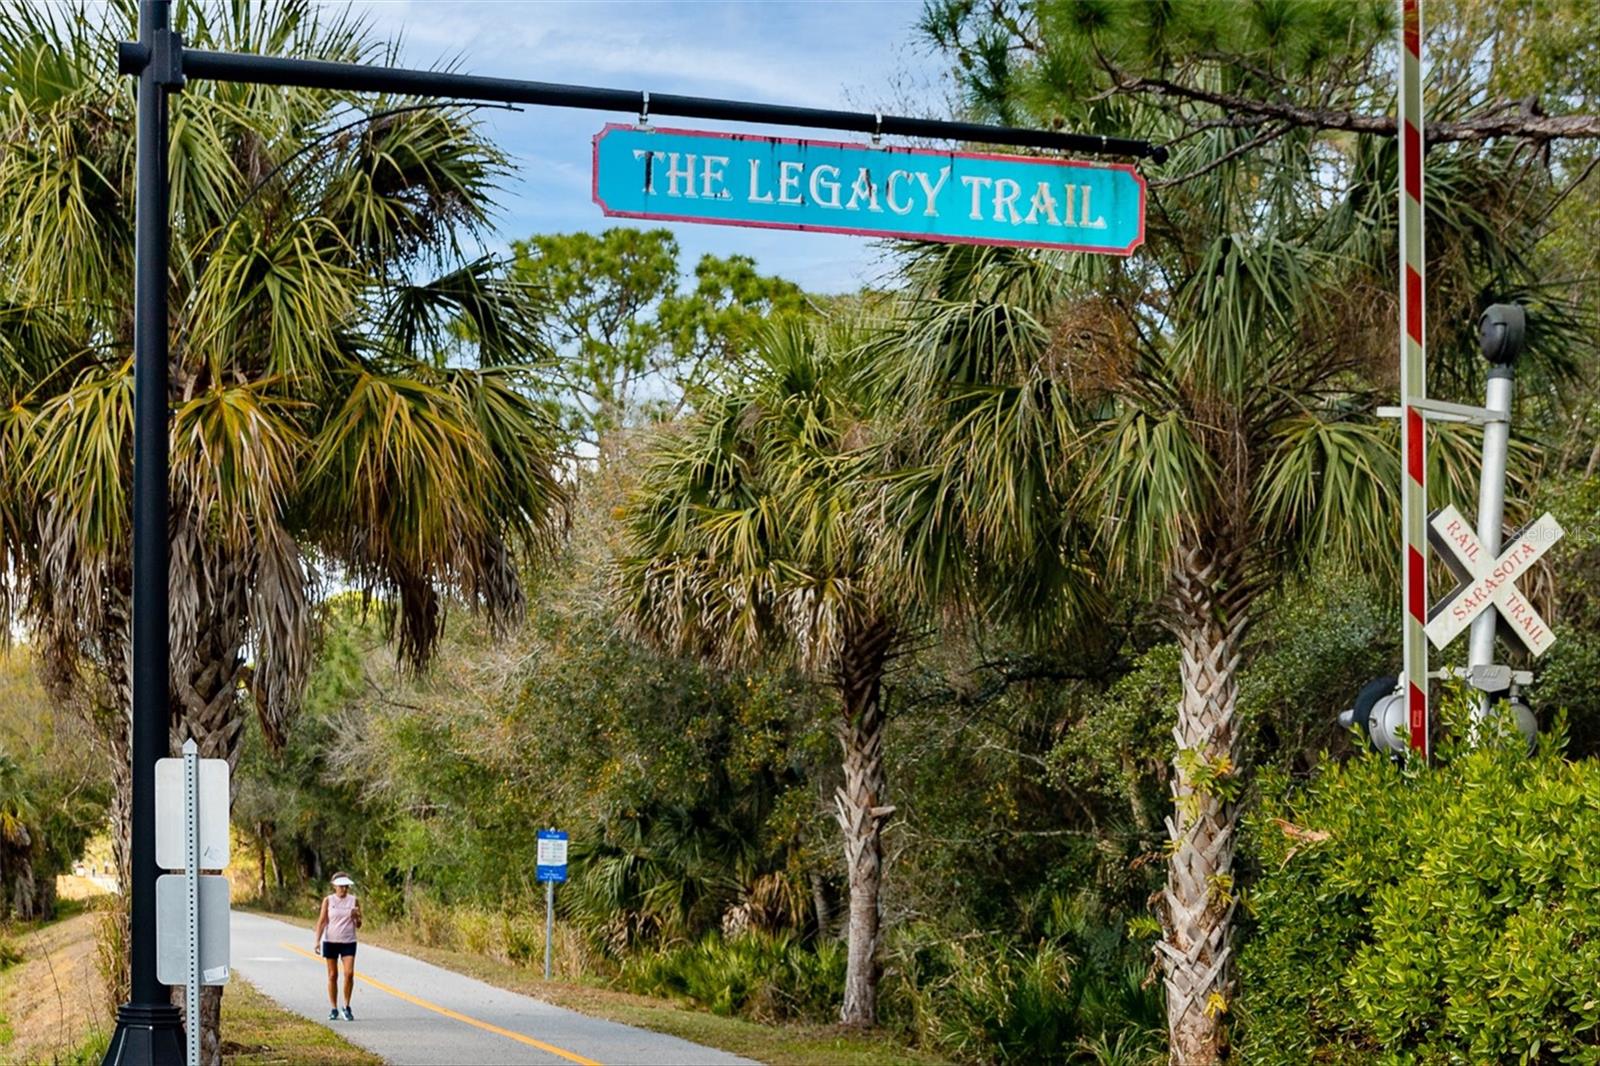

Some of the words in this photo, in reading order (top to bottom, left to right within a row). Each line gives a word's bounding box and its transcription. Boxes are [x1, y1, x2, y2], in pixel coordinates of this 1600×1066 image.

[632, 149, 733, 200] THE
[747, 158, 951, 217] LEGACY
[961, 175, 1107, 229] TRAIL
[1446, 520, 1480, 562] RAIL
[1453, 543, 1536, 621] SARASOTA
[1505, 593, 1544, 645] TRAIL
